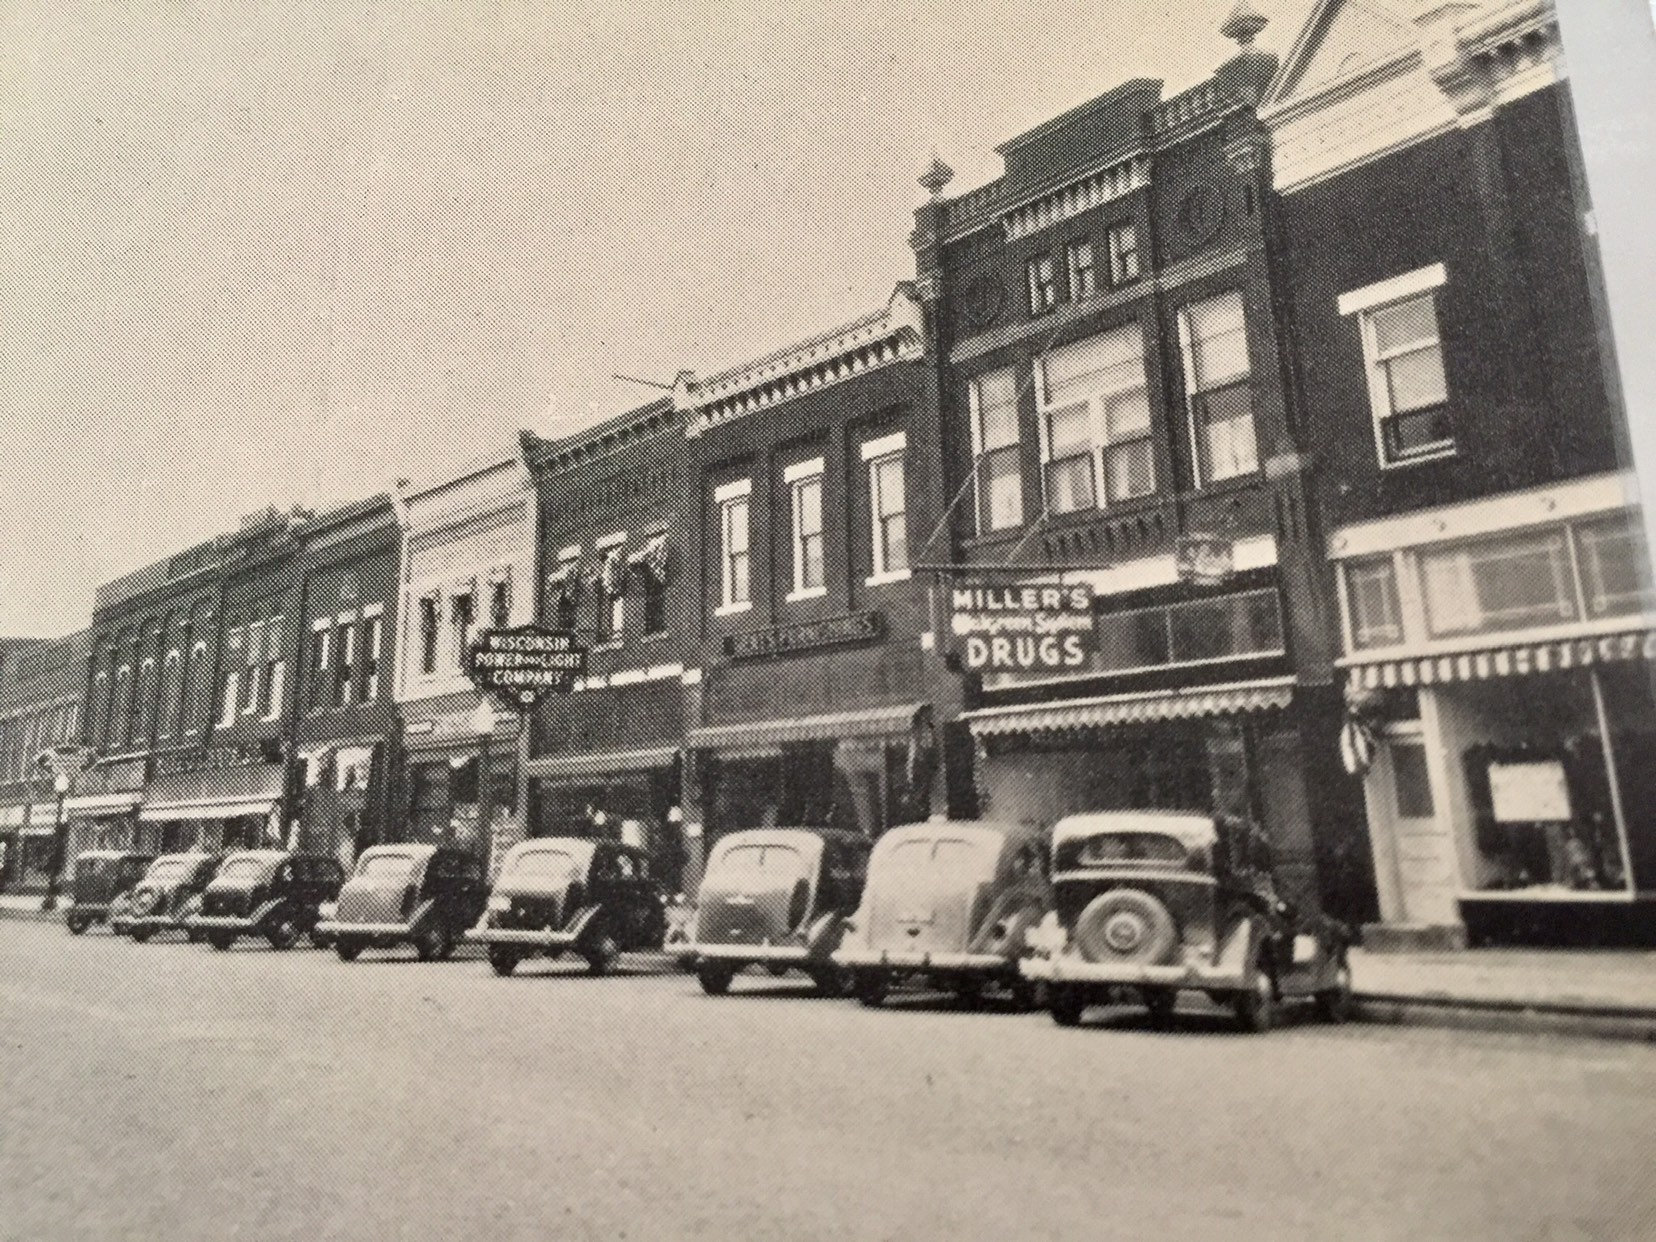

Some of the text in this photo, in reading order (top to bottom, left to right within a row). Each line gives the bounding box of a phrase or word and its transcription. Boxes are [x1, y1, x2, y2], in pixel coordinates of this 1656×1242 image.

[952, 588, 1090, 610] MILLER'S
[489, 635, 570, 651] WISCONSIN
[967, 635, 1085, 668] DRUGS
[475, 652, 522, 667] POWER
[541, 653, 582, 668] LIGHT
[493, 669, 563, 685] COMPANY
